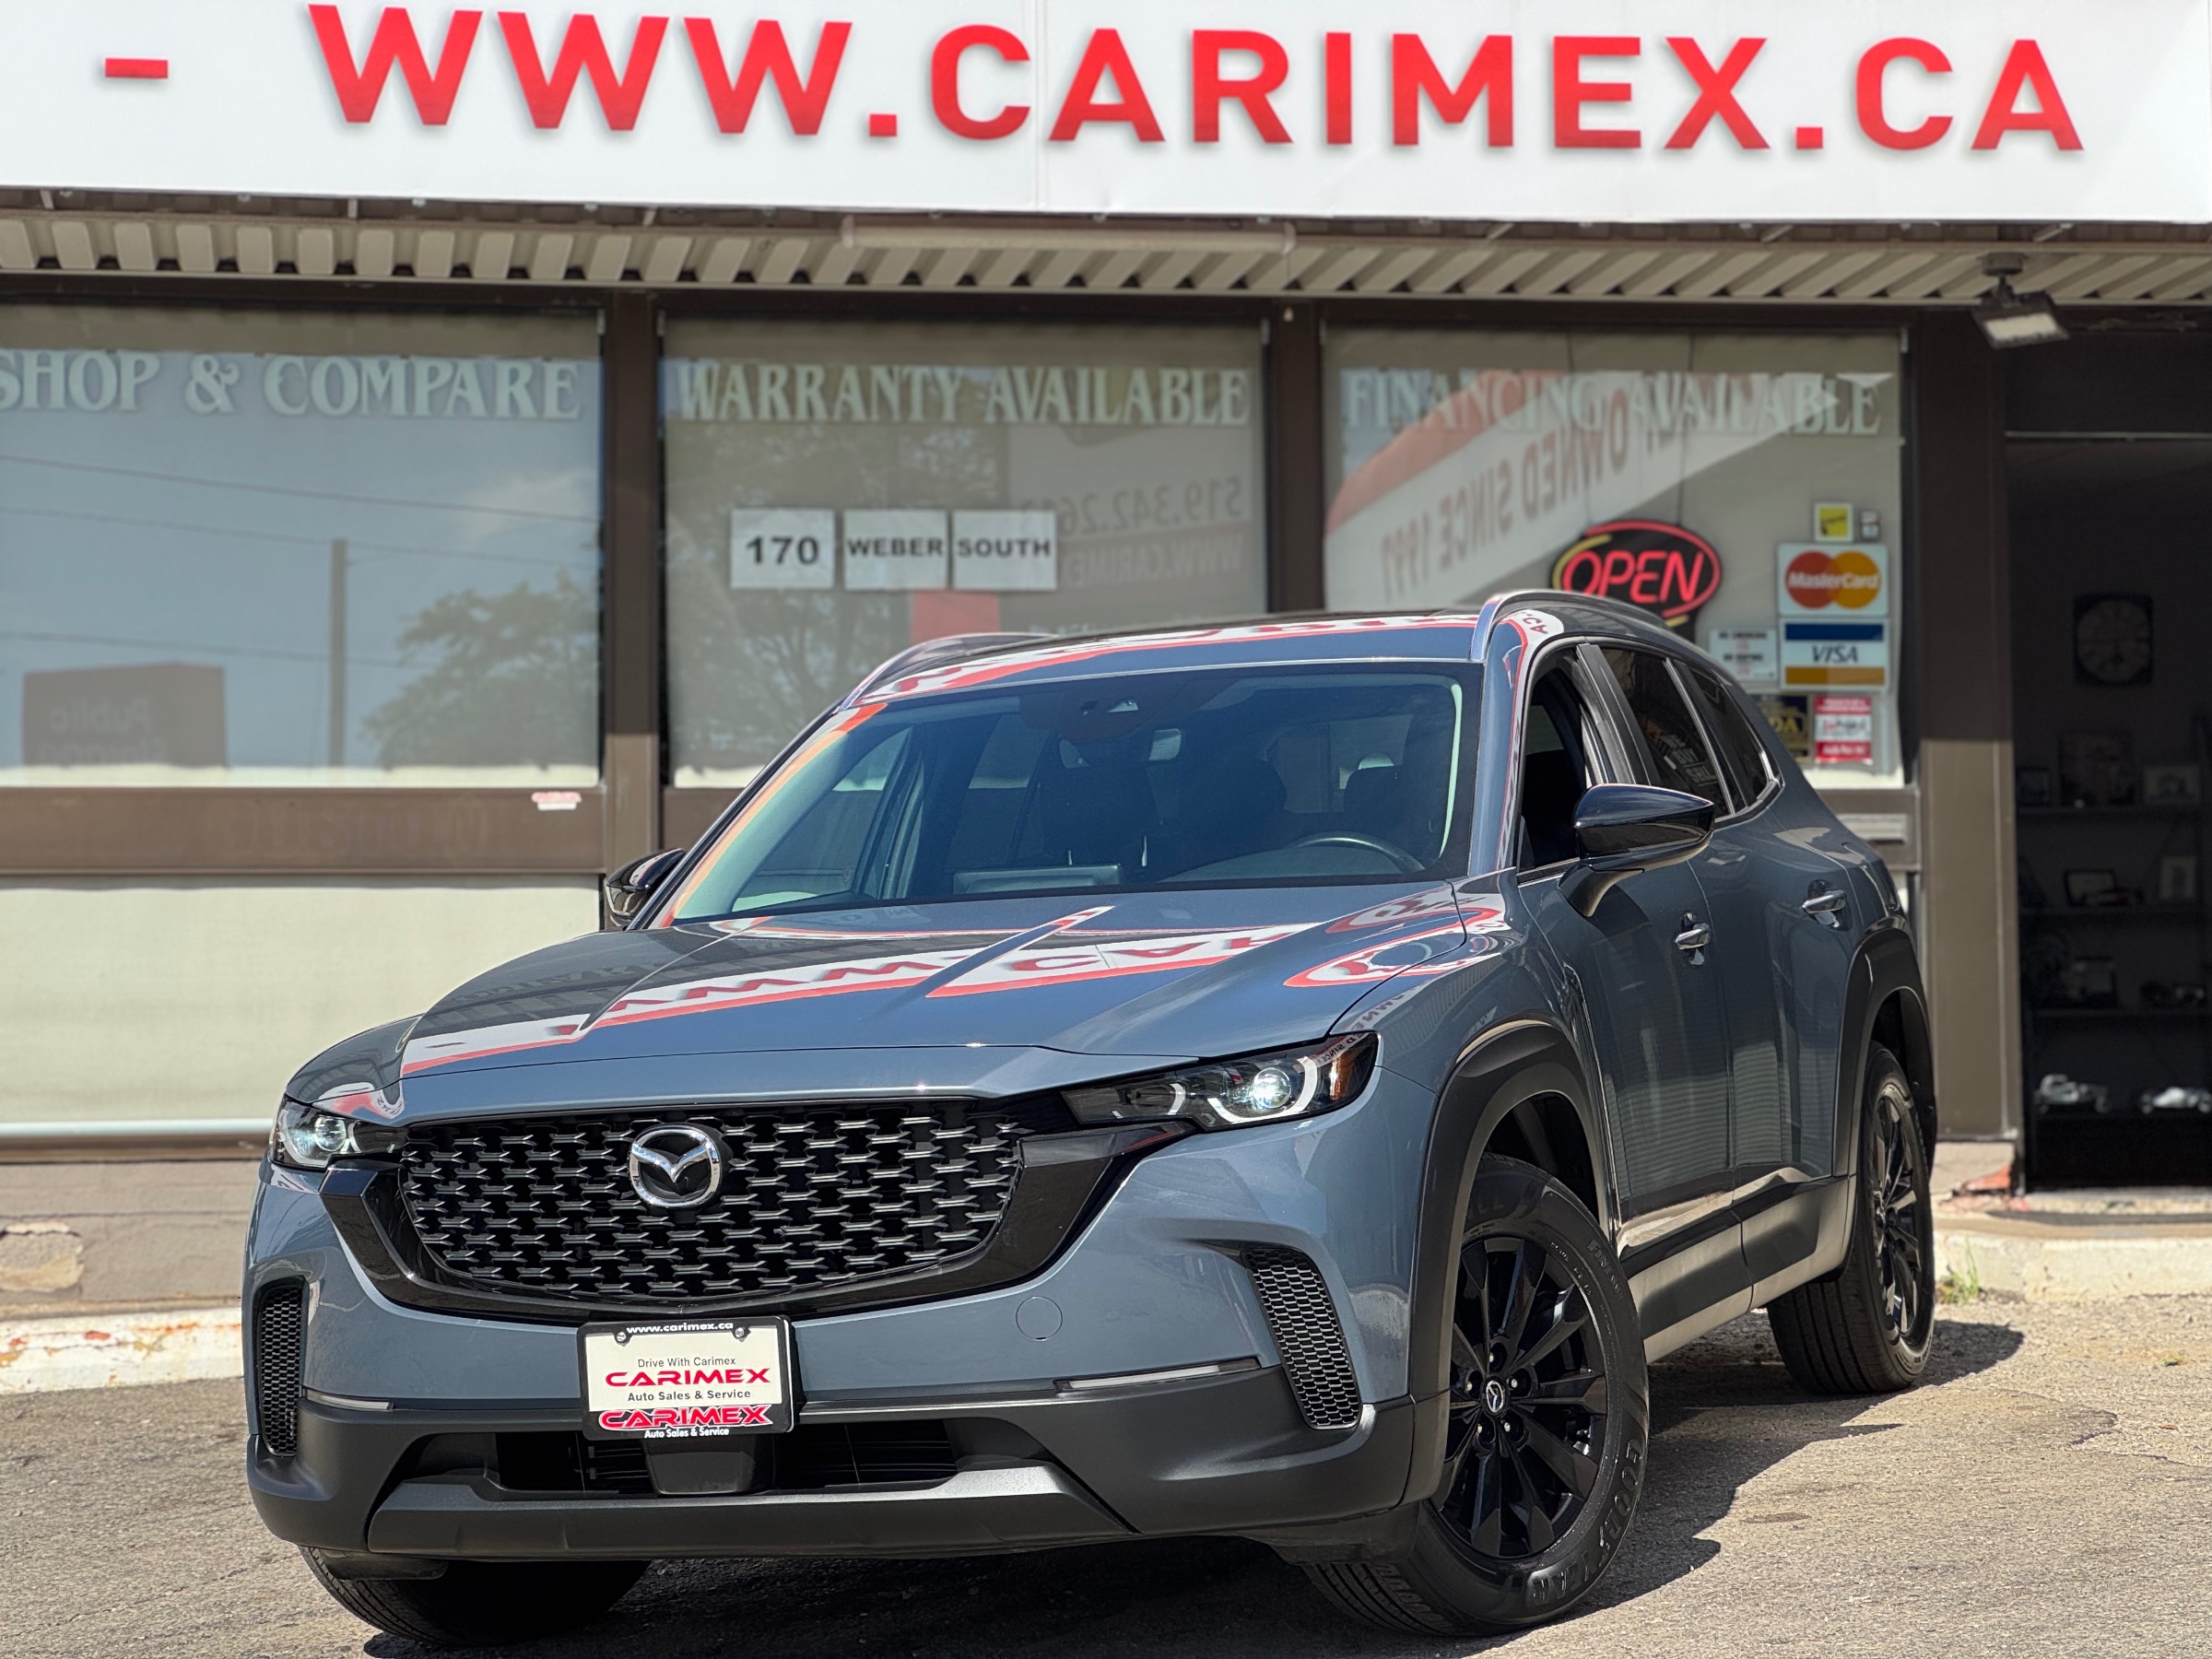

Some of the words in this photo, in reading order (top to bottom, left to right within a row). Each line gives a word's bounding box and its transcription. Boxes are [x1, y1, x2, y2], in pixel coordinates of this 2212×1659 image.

[309, 4, 2084, 151] WWW.CARIMEX.CA
[0, 349, 161, 412] SHOP
[184, 353, 241, 415] &
[264, 354, 582, 420] COMPARE
[676, 364, 963, 422] WARRANTY
[984, 366, 1251, 427] AVAILABLE
[1346, 371, 1605, 433] FINANCING
[1629, 372, 1882, 435] AVAILABLE
[746, 535, 820, 565] 170
[847, 536, 945, 559] WEBER
[957, 537, 1052, 559] SOUTH
[1561, 550, 1705, 604] OPEN
[1788, 571, 1879, 589] MasterCard
[1812, 645, 1859, 664] VISA
[1671, 747, 1700, 765] BUY
[1685, 765, 1718, 783] SELL
[626, 1322, 734, 1334] www.carimex.ca
[637, 1358, 665, 1368] Drive
[667, 1357, 690, 1367] With
[693, 1356, 736, 1366] Carimex
[605, 1368, 771, 1387] CARIMEX
[627, 1392, 654, 1402] Auto
[658, 1391, 691, 1401] Sales
[694, 1390, 703, 1400] &
[707, 1389, 751, 1399] Service
[599, 1404, 773, 1430] CARIMEX
[643, 1430, 665, 1440] Auto
[665, 1428, 690, 1439] Sales
[690, 1428, 698, 1437] &
[699, 1426, 730, 1436] Service
